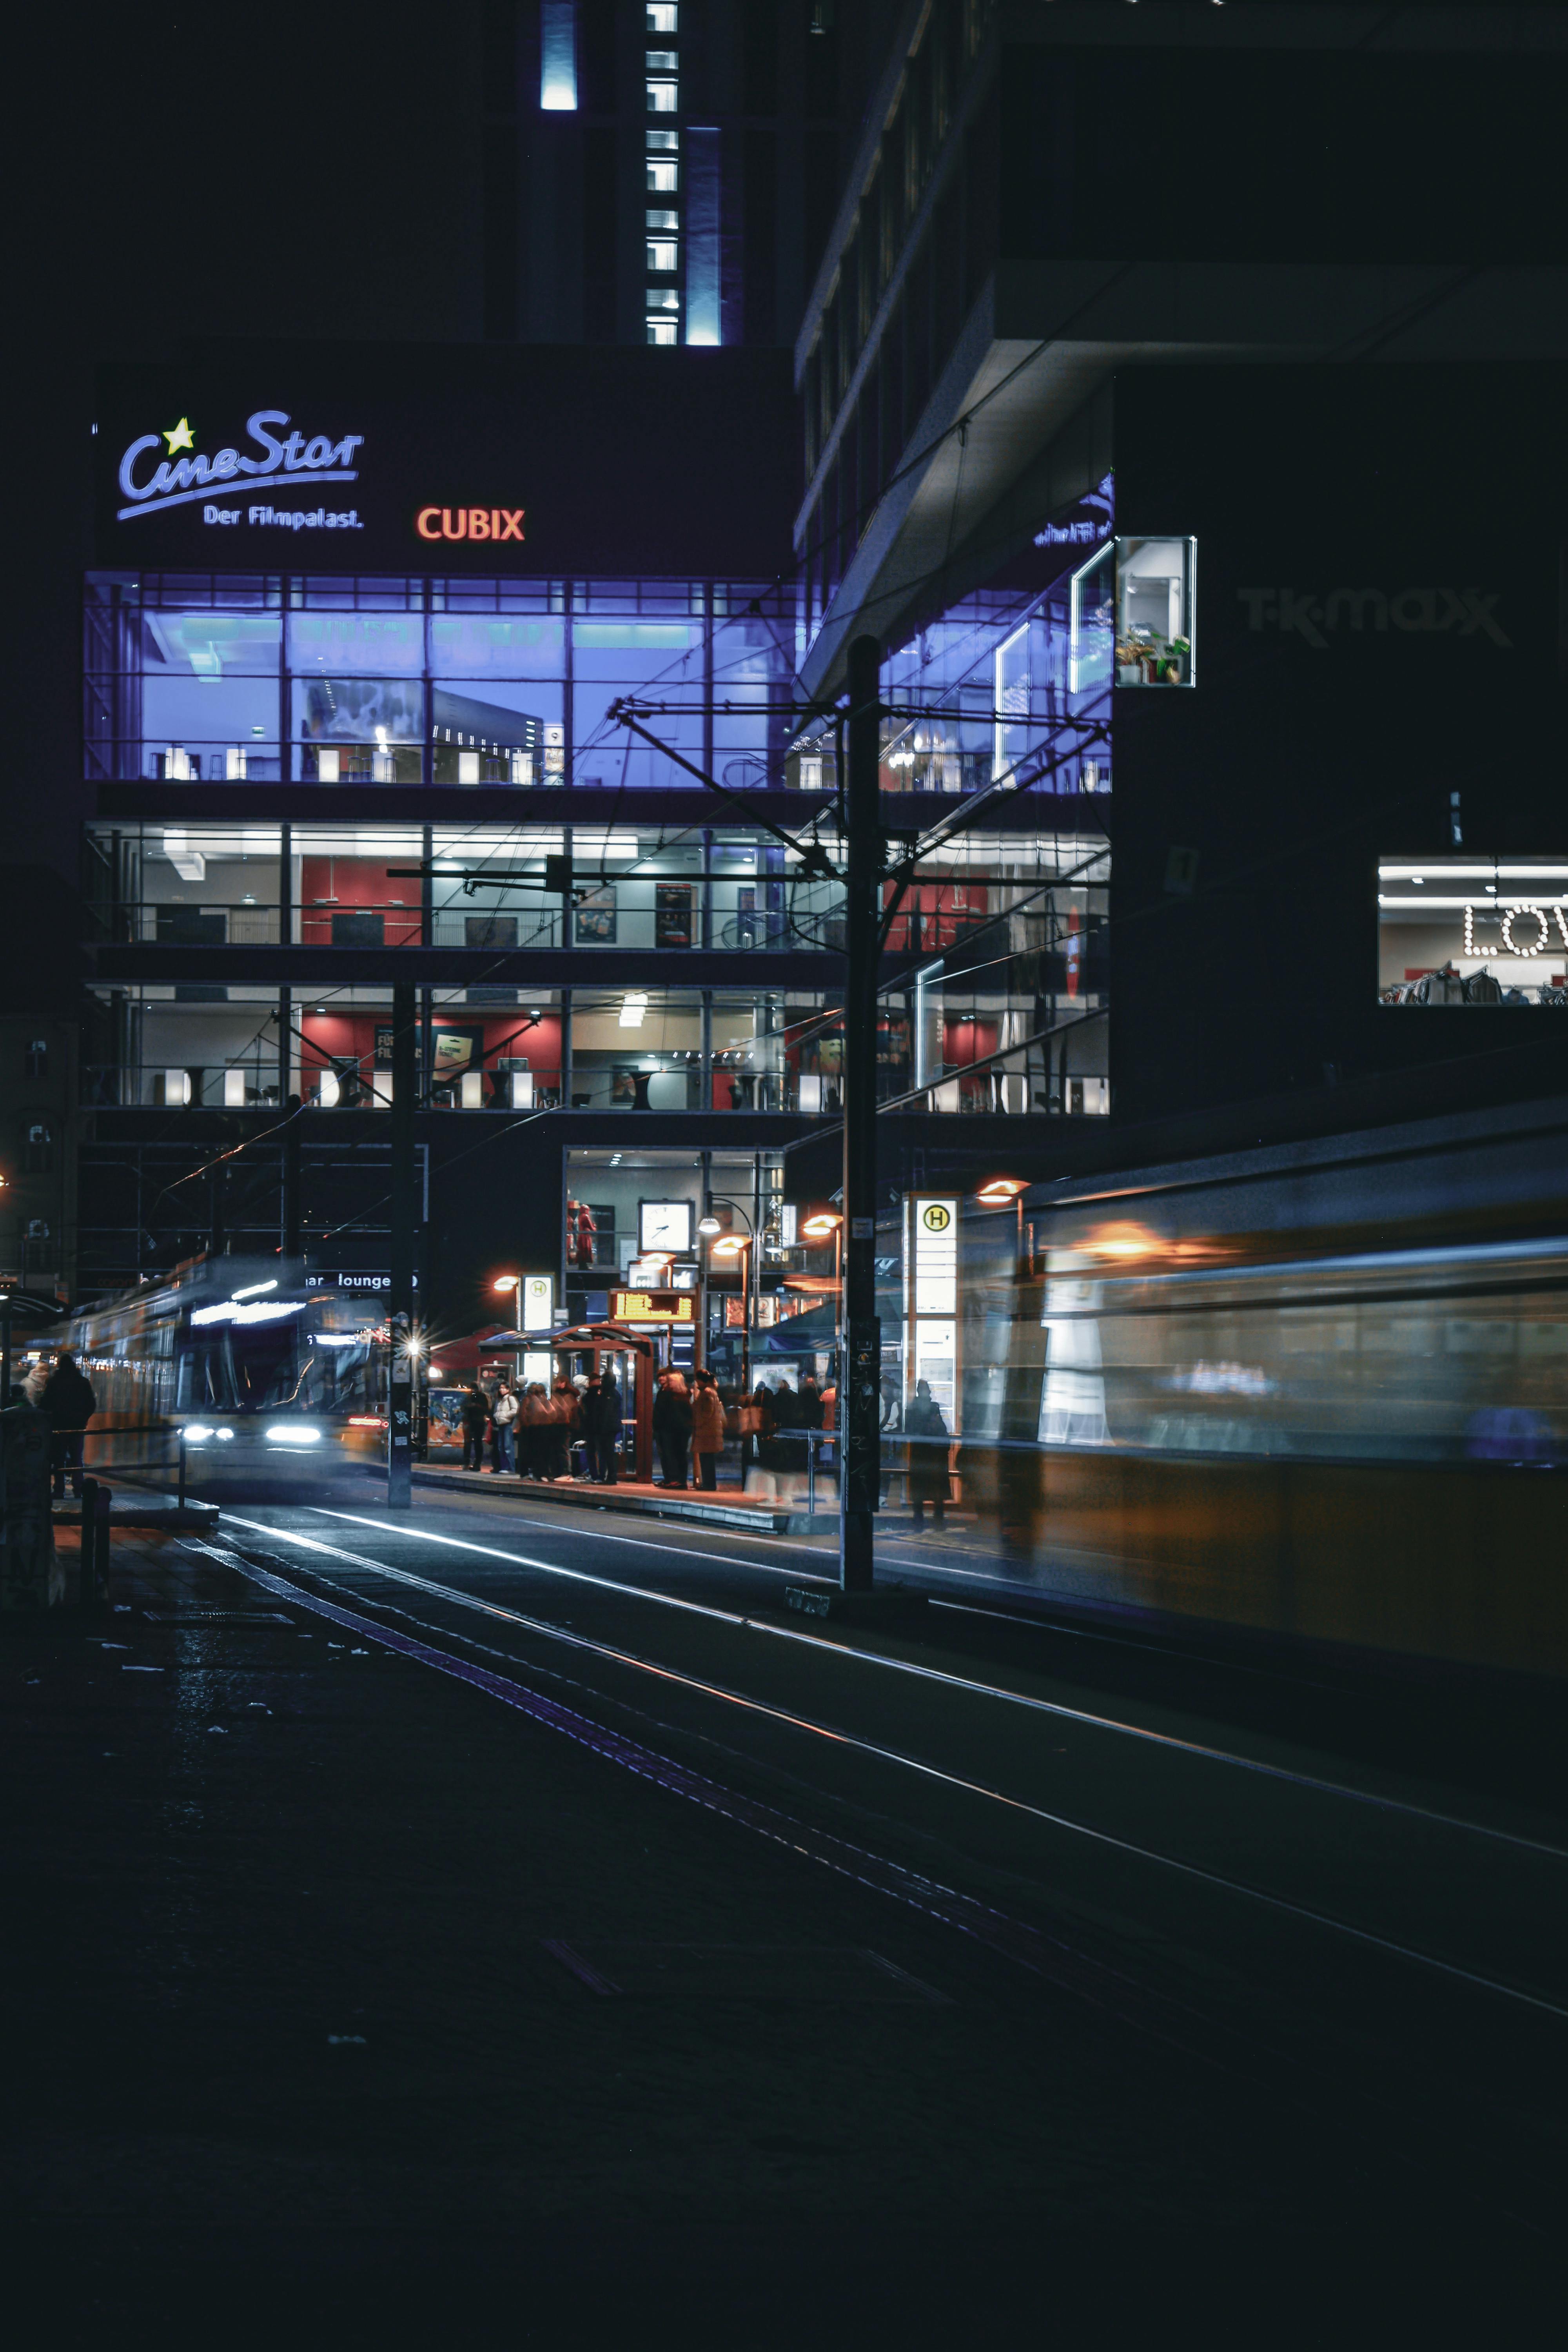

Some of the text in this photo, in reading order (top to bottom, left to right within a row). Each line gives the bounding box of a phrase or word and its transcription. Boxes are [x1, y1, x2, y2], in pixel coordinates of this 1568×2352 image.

[119, 410, 364, 500] CineStar
[203, 505, 365, 531] Der Filmpalast.
[417, 508, 526, 540] CUBIX
[930, 1211, 943, 1226] H
[338, 1273, 391, 1290] lounge
